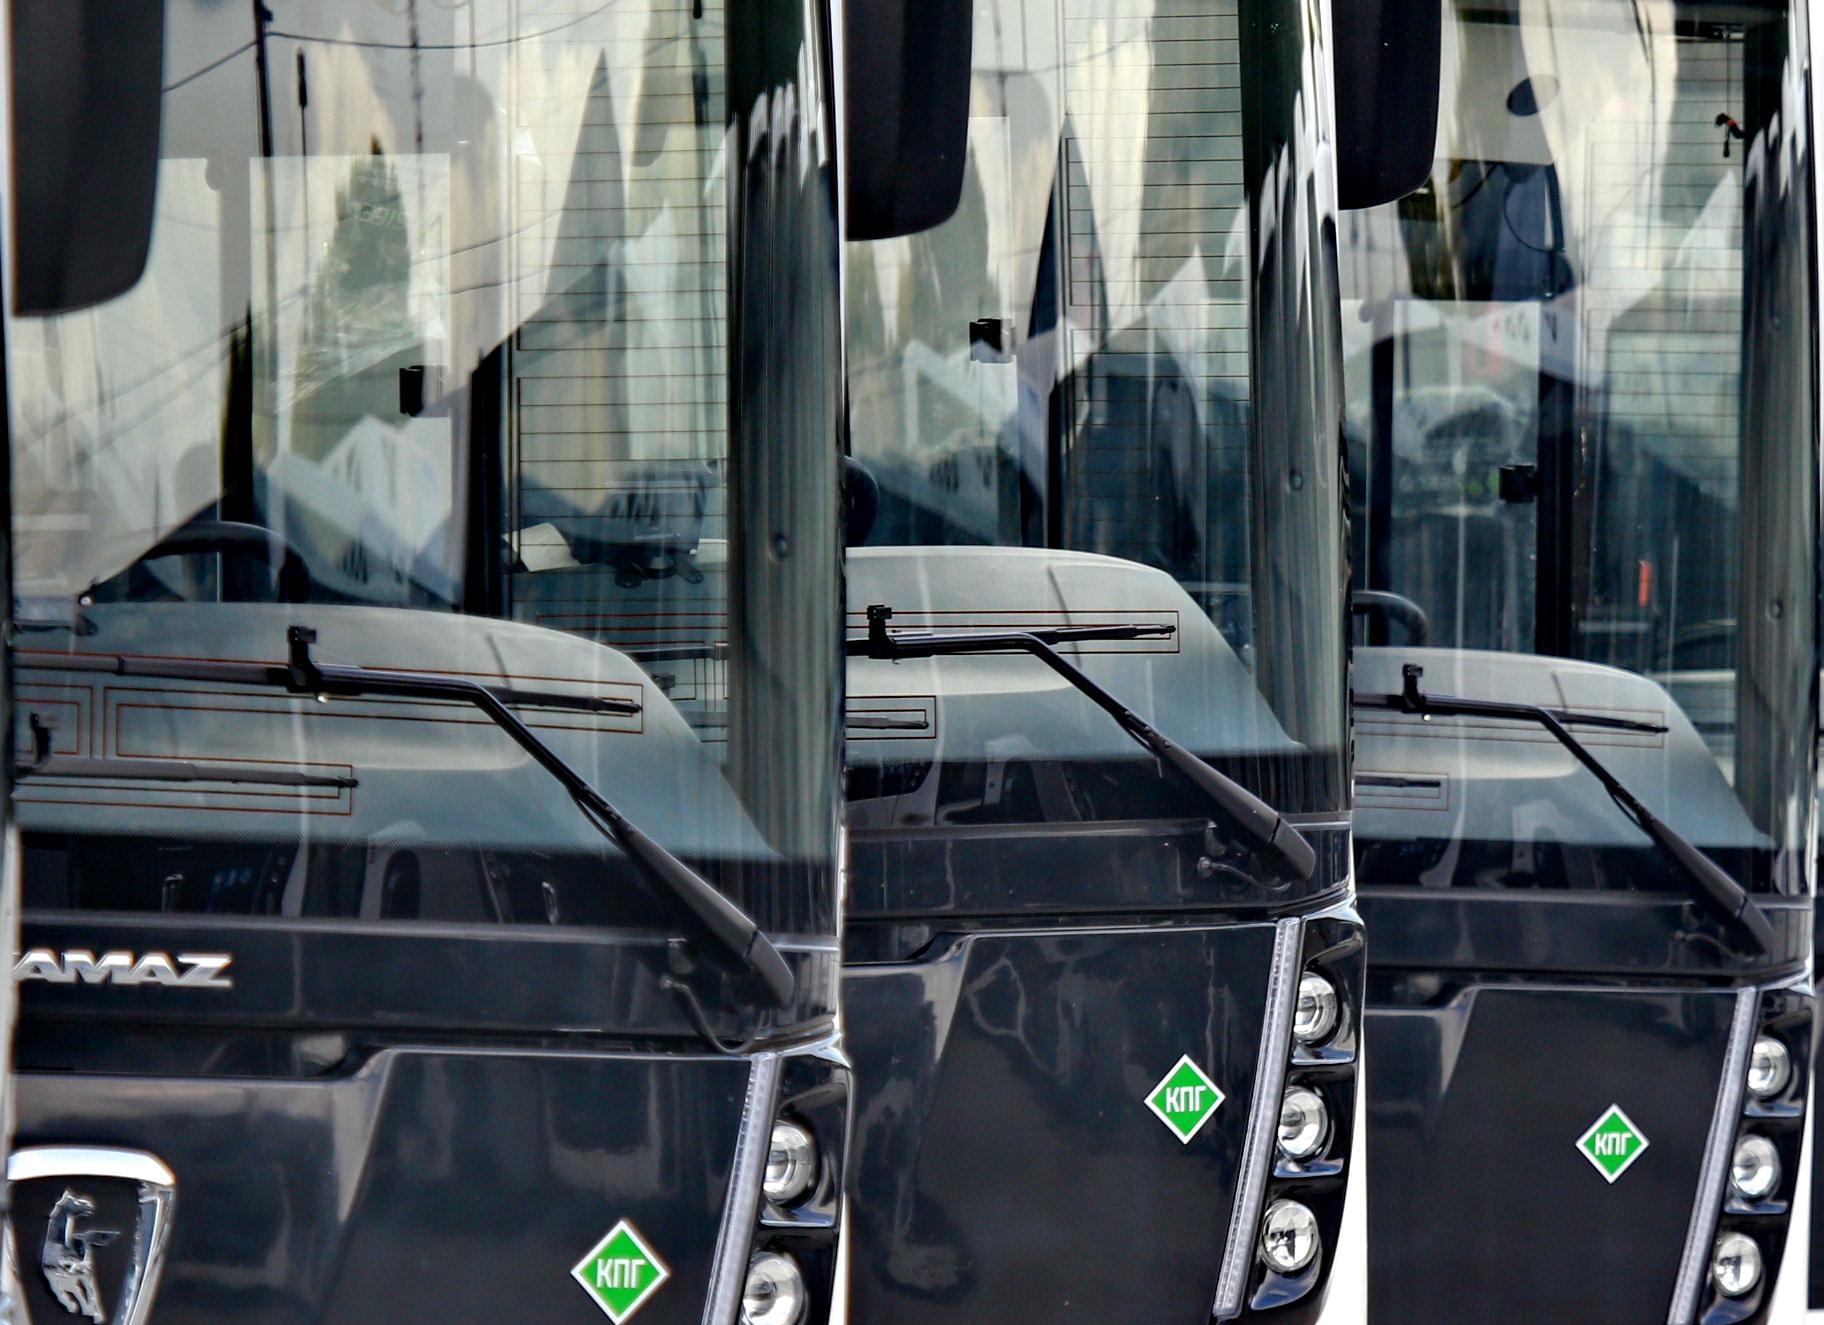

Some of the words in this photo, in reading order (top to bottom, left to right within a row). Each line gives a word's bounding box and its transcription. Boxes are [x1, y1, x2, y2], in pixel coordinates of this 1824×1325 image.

[10, 949, 232, 986] AMAZ
[1166, 1084, 1207, 1113] КПГ
[1594, 1131, 1634, 1156] КПГ
[596, 1257, 647, 1289] КПГ
